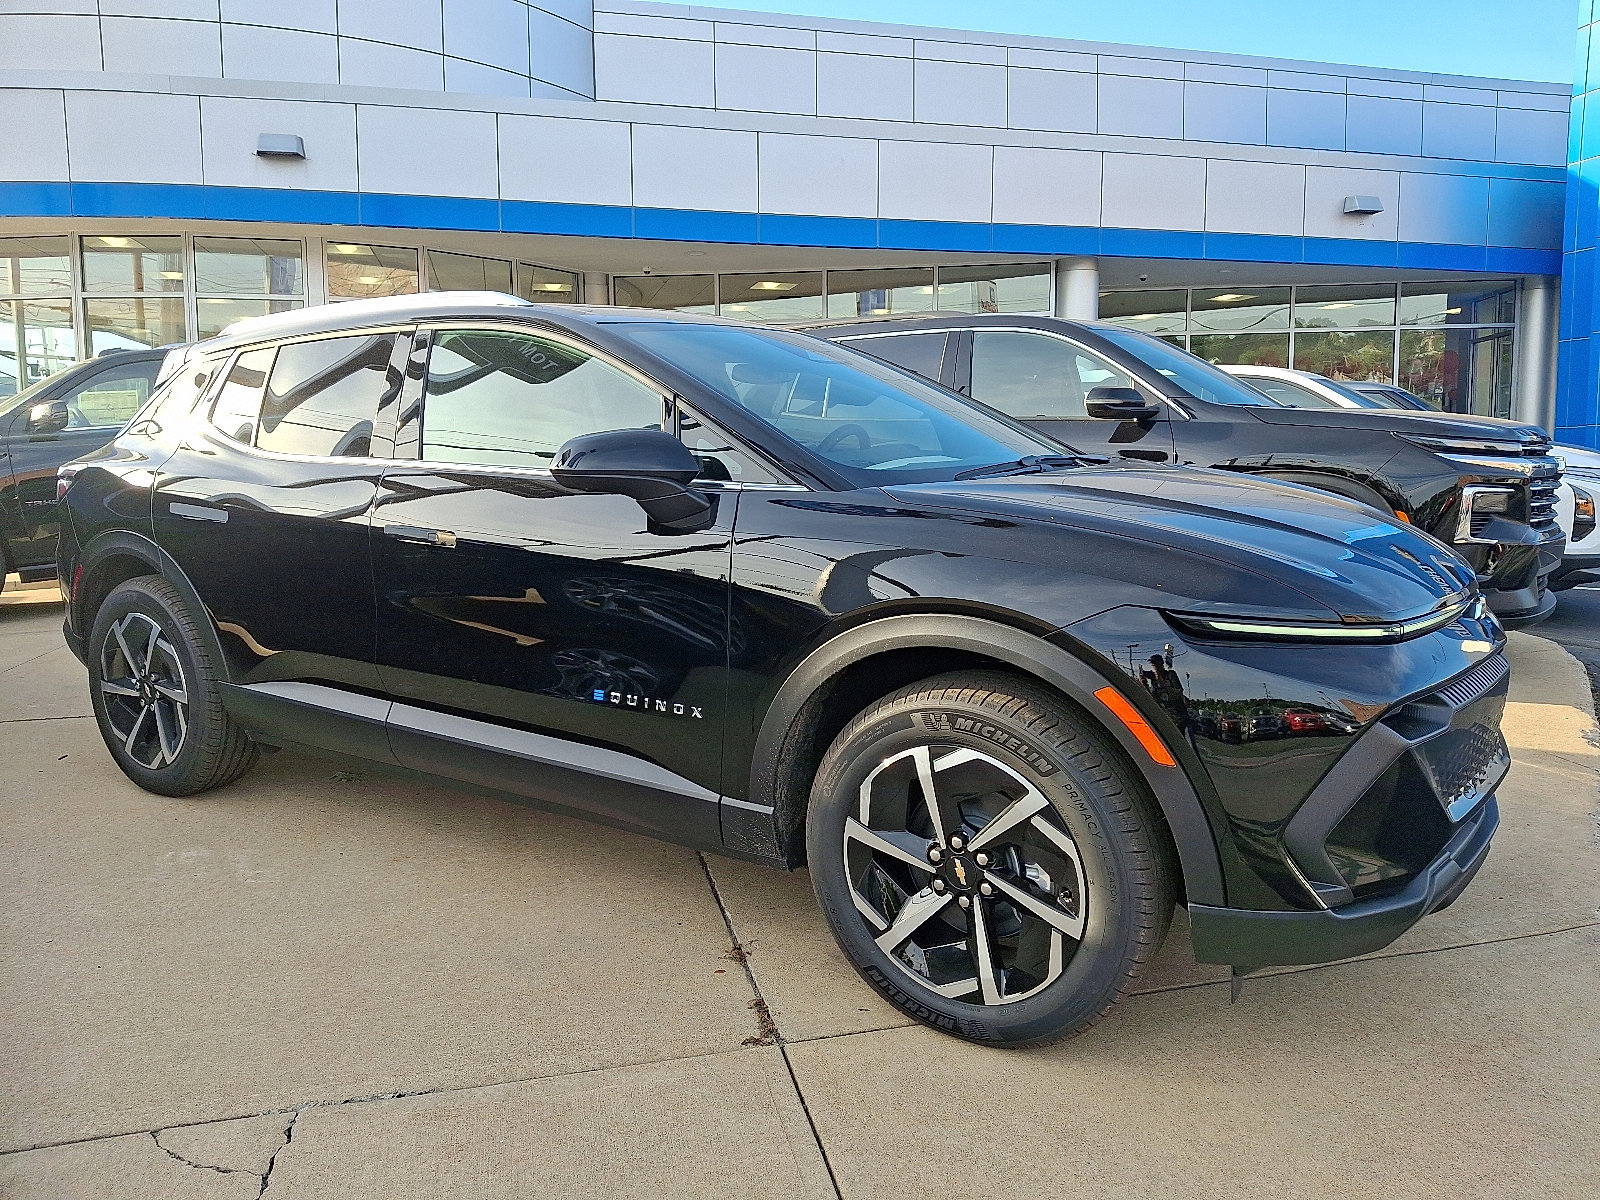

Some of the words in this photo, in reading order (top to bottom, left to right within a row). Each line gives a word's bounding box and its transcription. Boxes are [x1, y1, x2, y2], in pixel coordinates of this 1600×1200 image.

[593, 689, 703, 719] EQUINOX
[955, 717, 1054, 774] MICHELIN
[1062, 783, 1103, 838] PRIMACY
[1099, 844, 1110, 863] ALL
[867, 969, 956, 1029] MICHELIN
